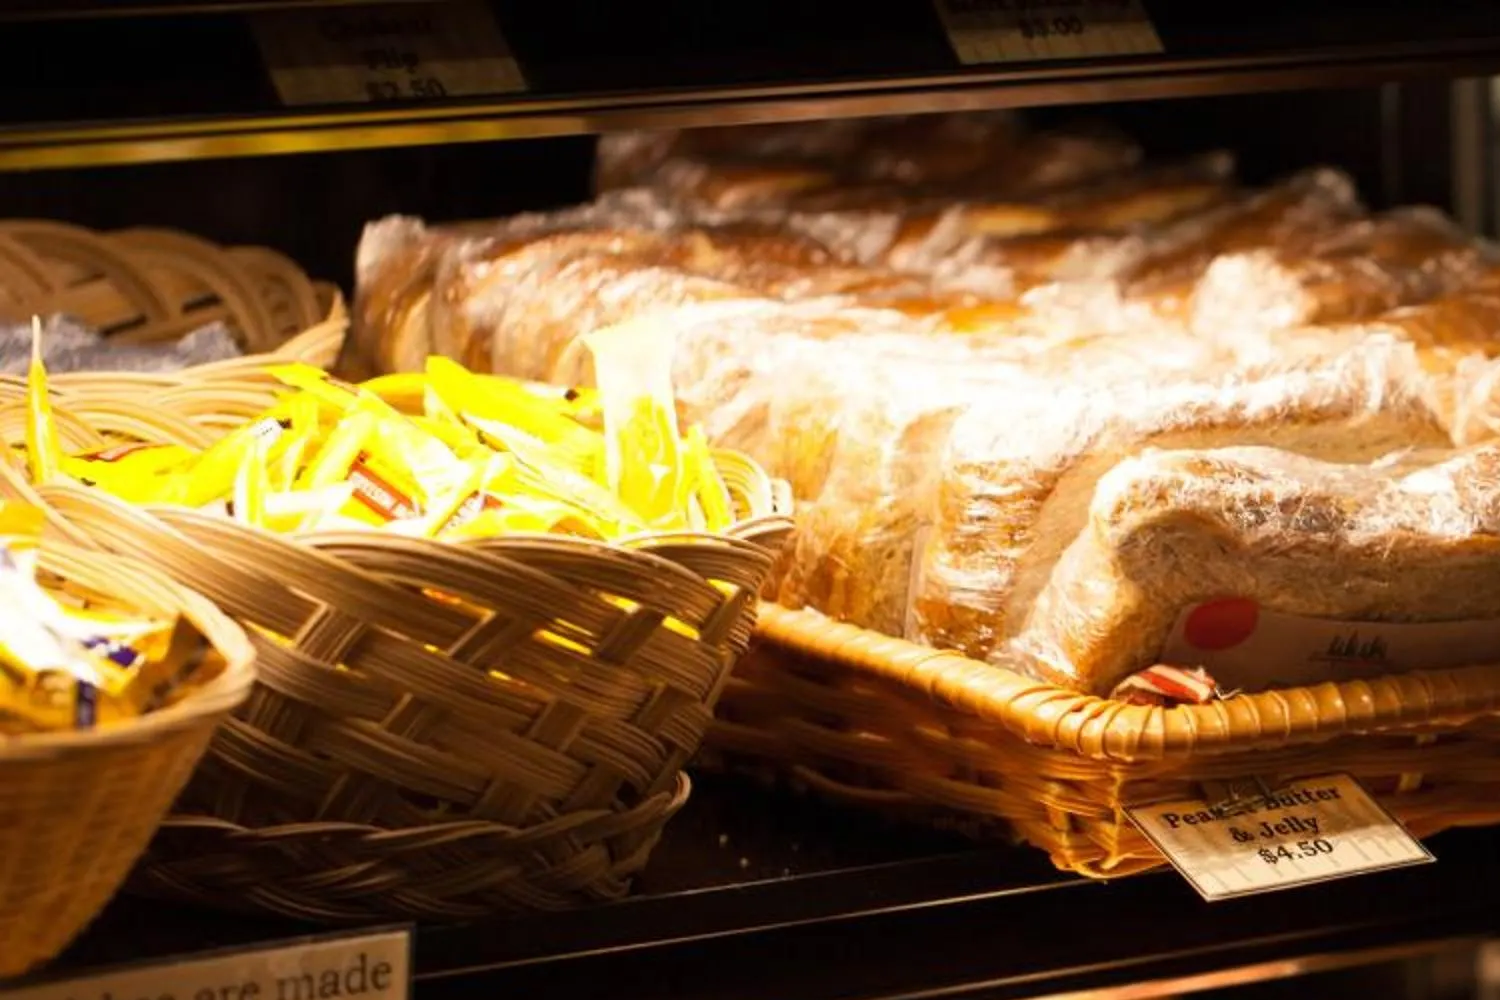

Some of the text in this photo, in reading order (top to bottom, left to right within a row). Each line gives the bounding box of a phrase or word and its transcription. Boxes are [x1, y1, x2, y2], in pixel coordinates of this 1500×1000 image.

[1162, 803, 1258, 829] Pea
[1229, 816, 1320, 843] & Jelly
[1258, 838, 1334, 865] $4.50
